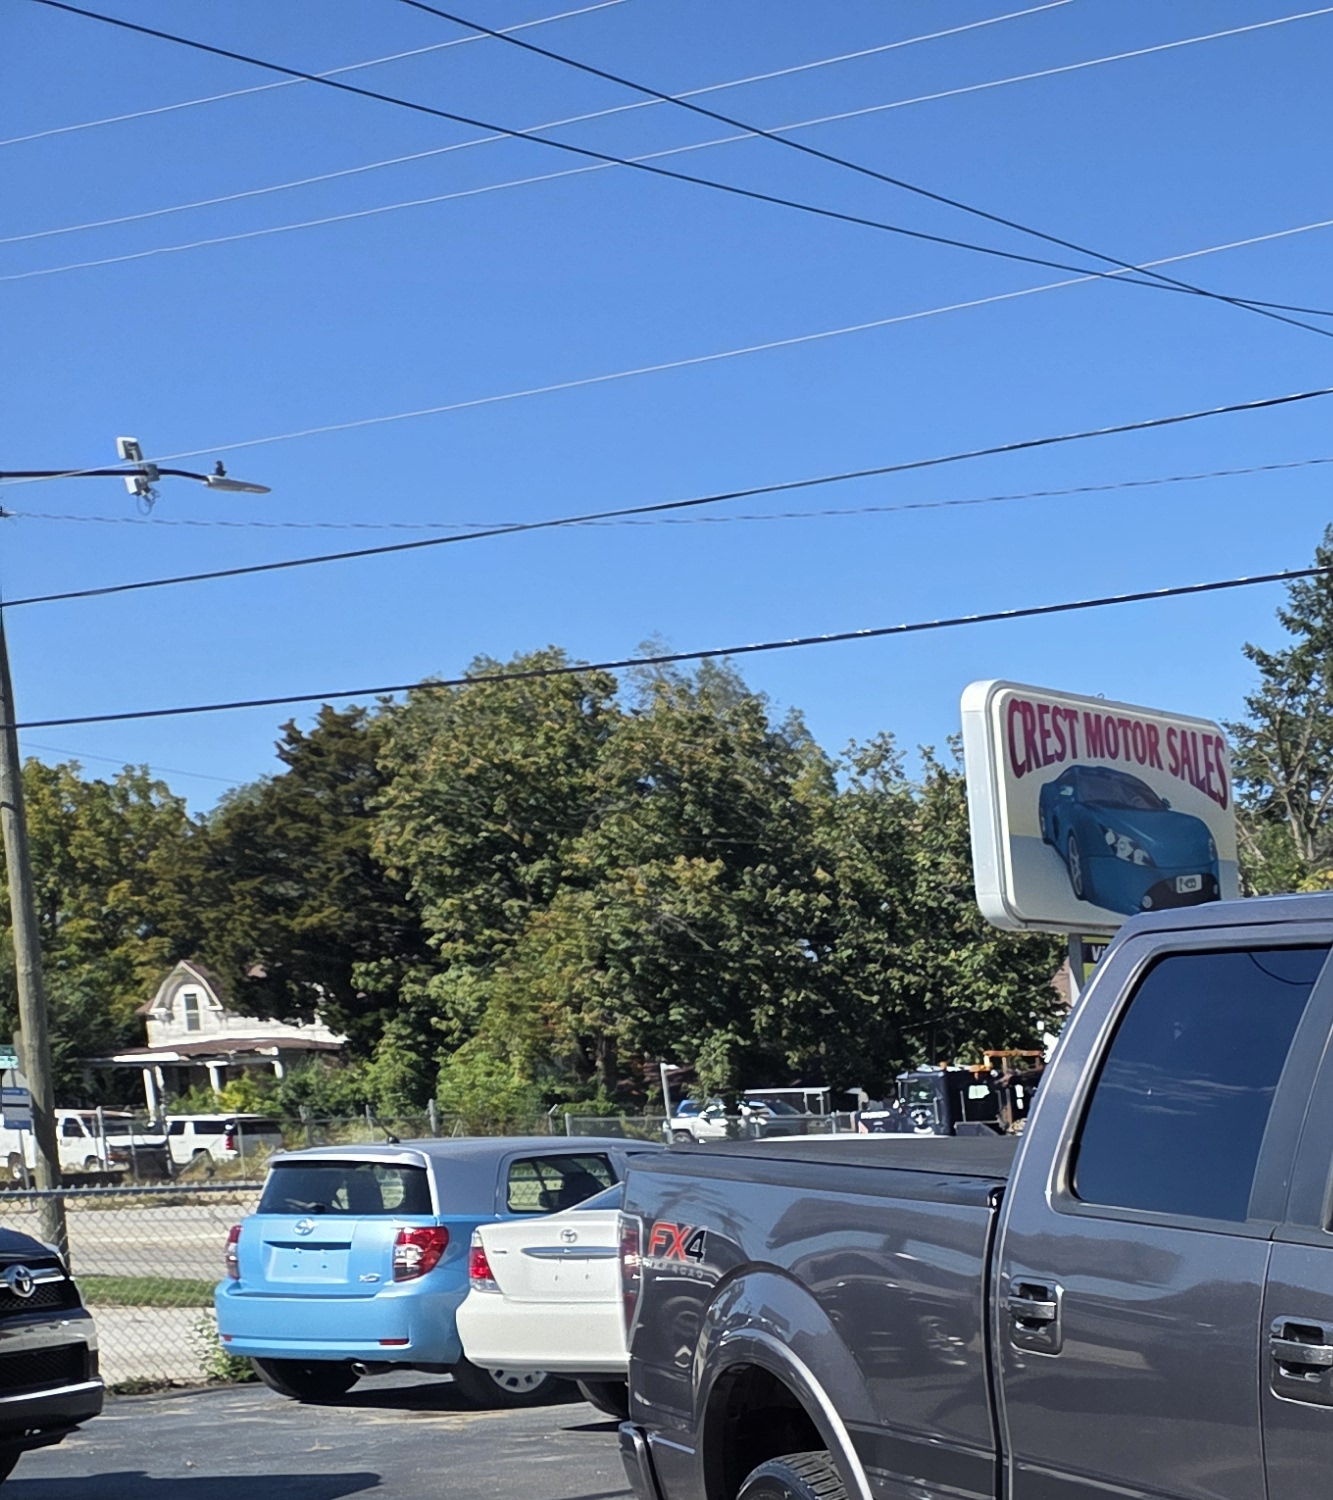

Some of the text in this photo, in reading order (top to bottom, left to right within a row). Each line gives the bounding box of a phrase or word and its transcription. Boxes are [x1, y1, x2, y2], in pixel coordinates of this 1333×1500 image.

[1008, 698, 1228, 811] CREST MOTOR SALES
[648, 1220, 708, 1264] FX4
